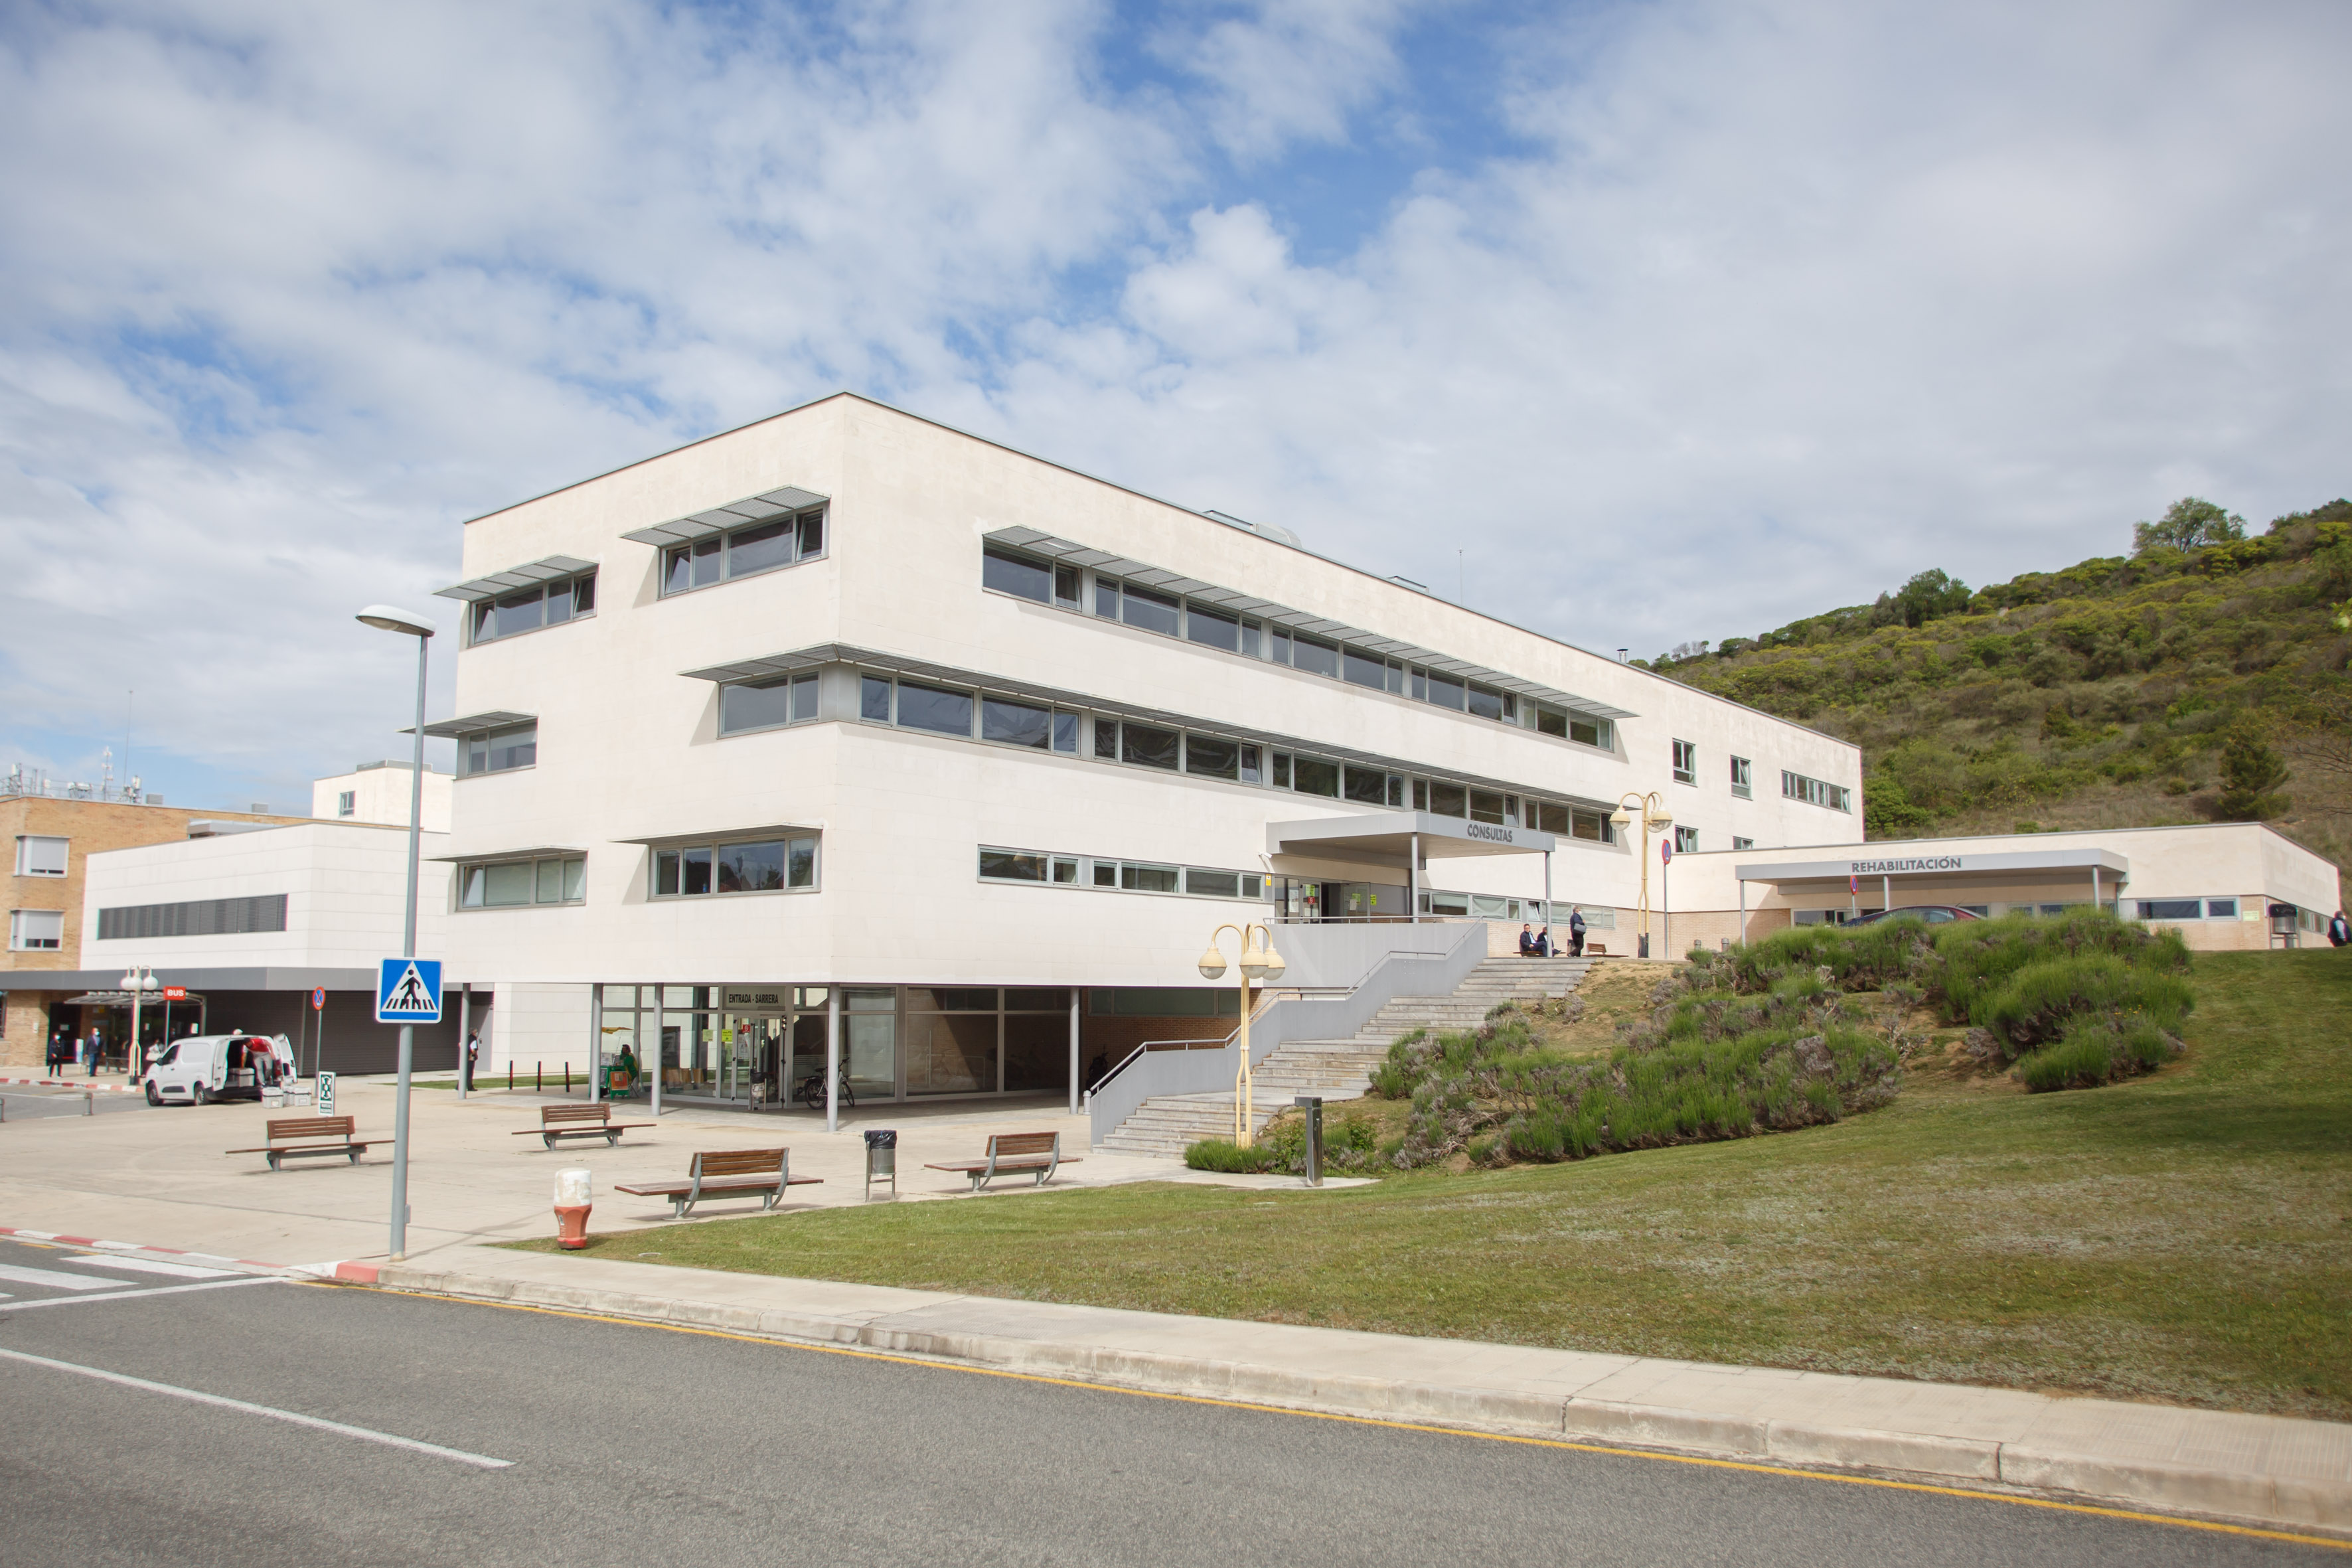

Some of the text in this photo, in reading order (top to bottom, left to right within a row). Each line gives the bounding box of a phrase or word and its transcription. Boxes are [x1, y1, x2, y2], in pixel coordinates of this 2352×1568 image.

[1467, 823, 1513, 843] CONSULTAS
[1851, 856, 1962, 873] REHABILITACIÓN
[167, 988, 185, 997] BUS
[729, 994, 751, 1003] ENTRADA
[755, 994, 779, 1004] SARRERA
